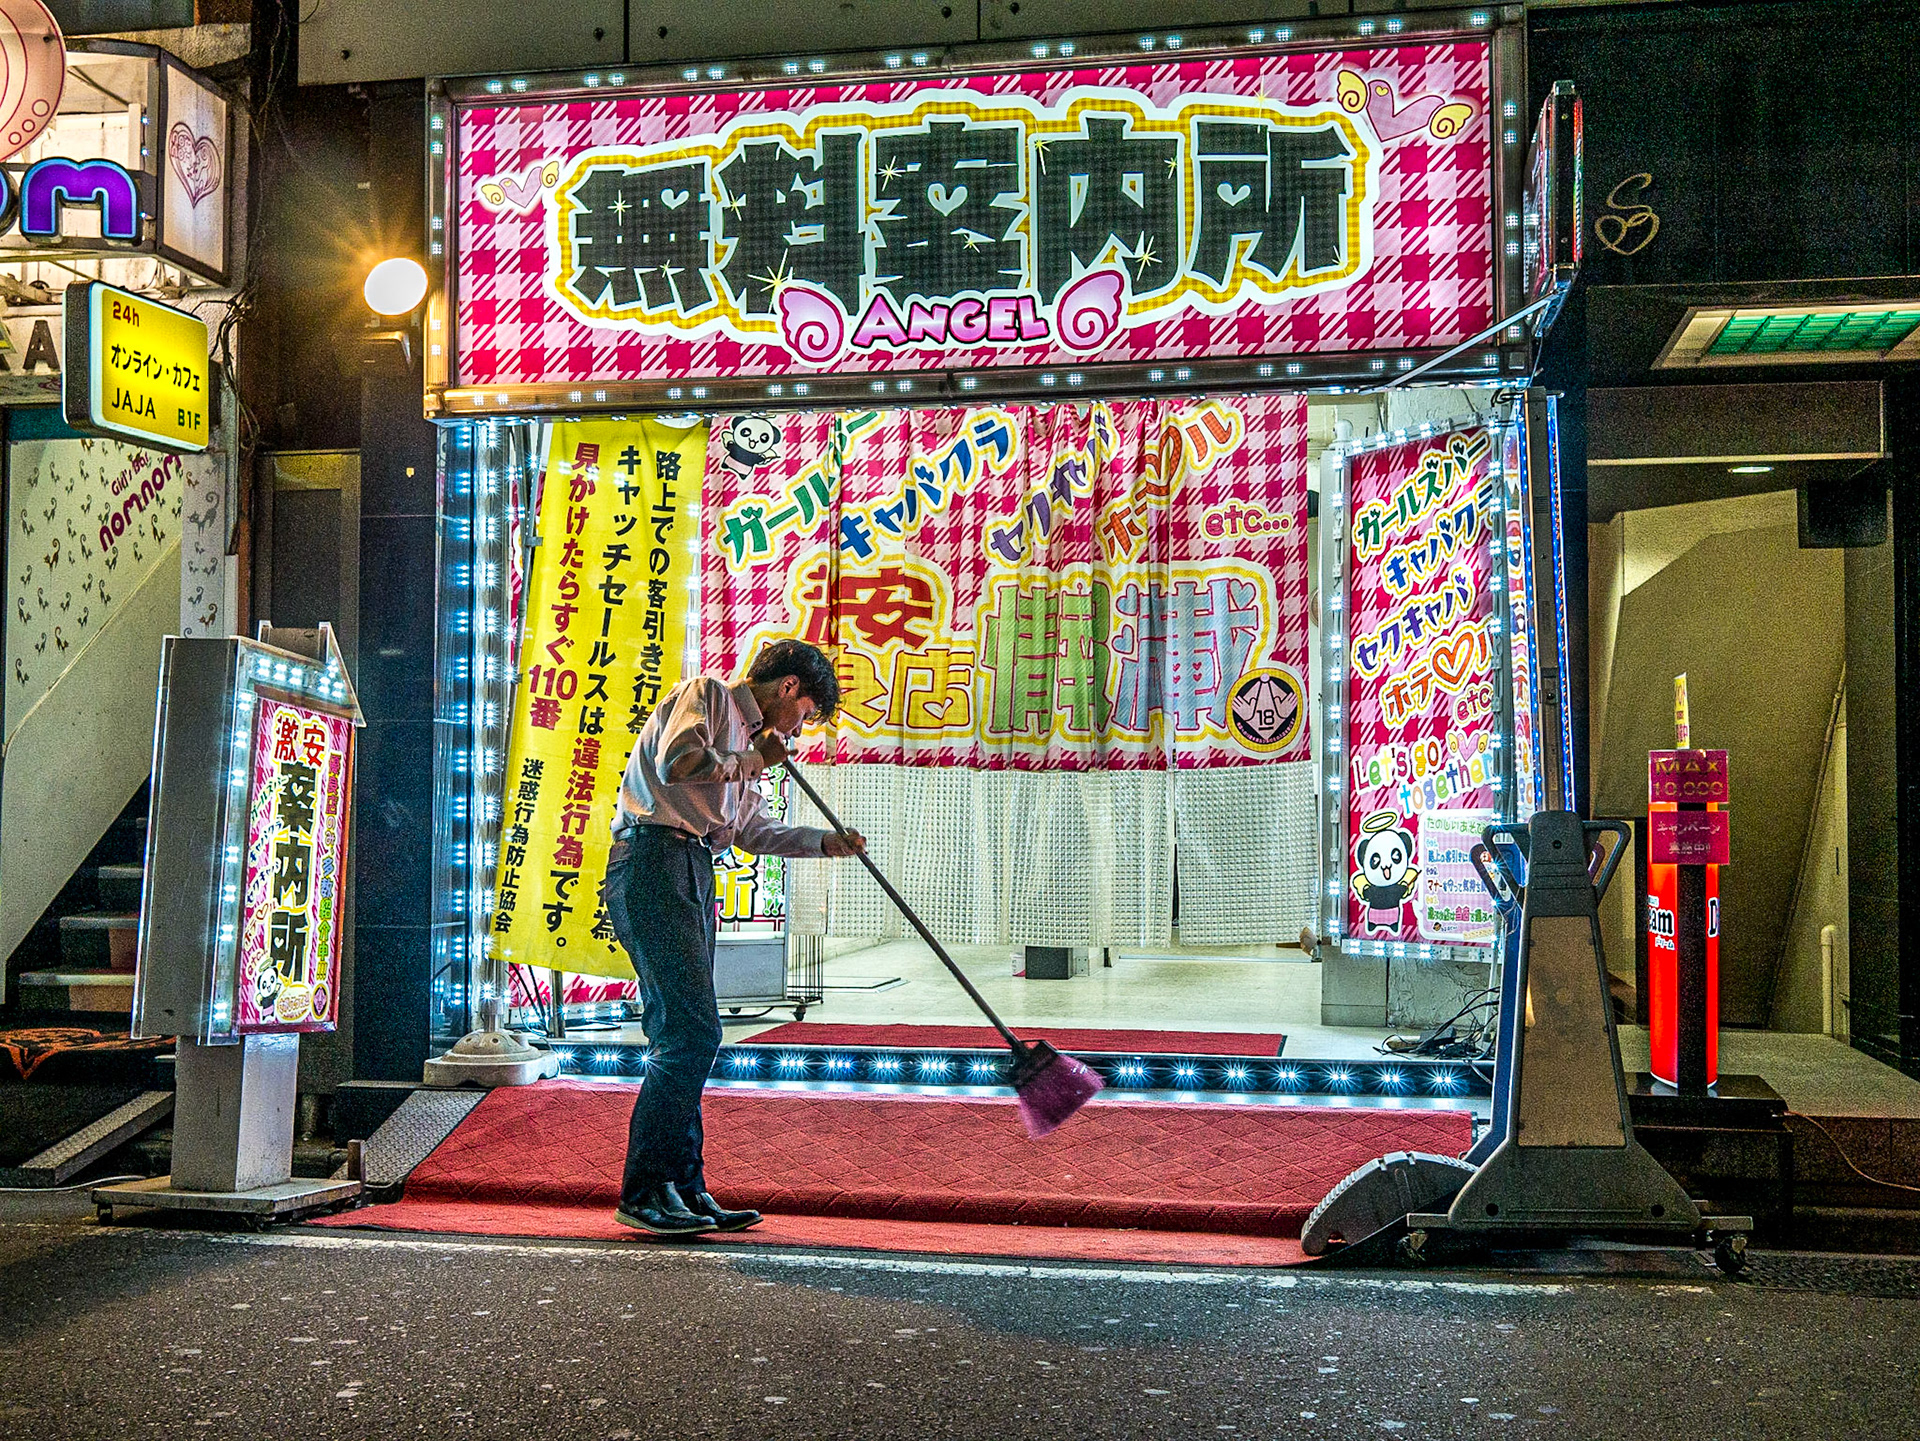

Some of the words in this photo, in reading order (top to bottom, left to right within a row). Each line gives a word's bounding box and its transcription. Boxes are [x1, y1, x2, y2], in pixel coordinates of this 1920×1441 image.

[569, 117, 1350, 315] 無料案内所
[112, 301, 141, 328] 24h
[852, 293, 1050, 348] ANGEL
[111, 343, 202, 393] オンライン・カフェ
[111, 387, 157, 420] JAJA
[177, 407, 202, 431] B1F
[840, 418, 1009, 559] キャバクラ
[1358, 437, 1487, 552] ガールズバー
[1357, 573, 1469, 671] セクキャバ
[1354, 747, 1409, 791] Let's
[1414, 741, 1439, 778] go
[1399, 752, 1493, 815] together
[1653, 781, 1724, 797] 10,000
[1655, 759, 1721, 776] MAX
[271, 762, 317, 982] 案内所
[494, 758, 546, 934] 迷惑行為防止協会
